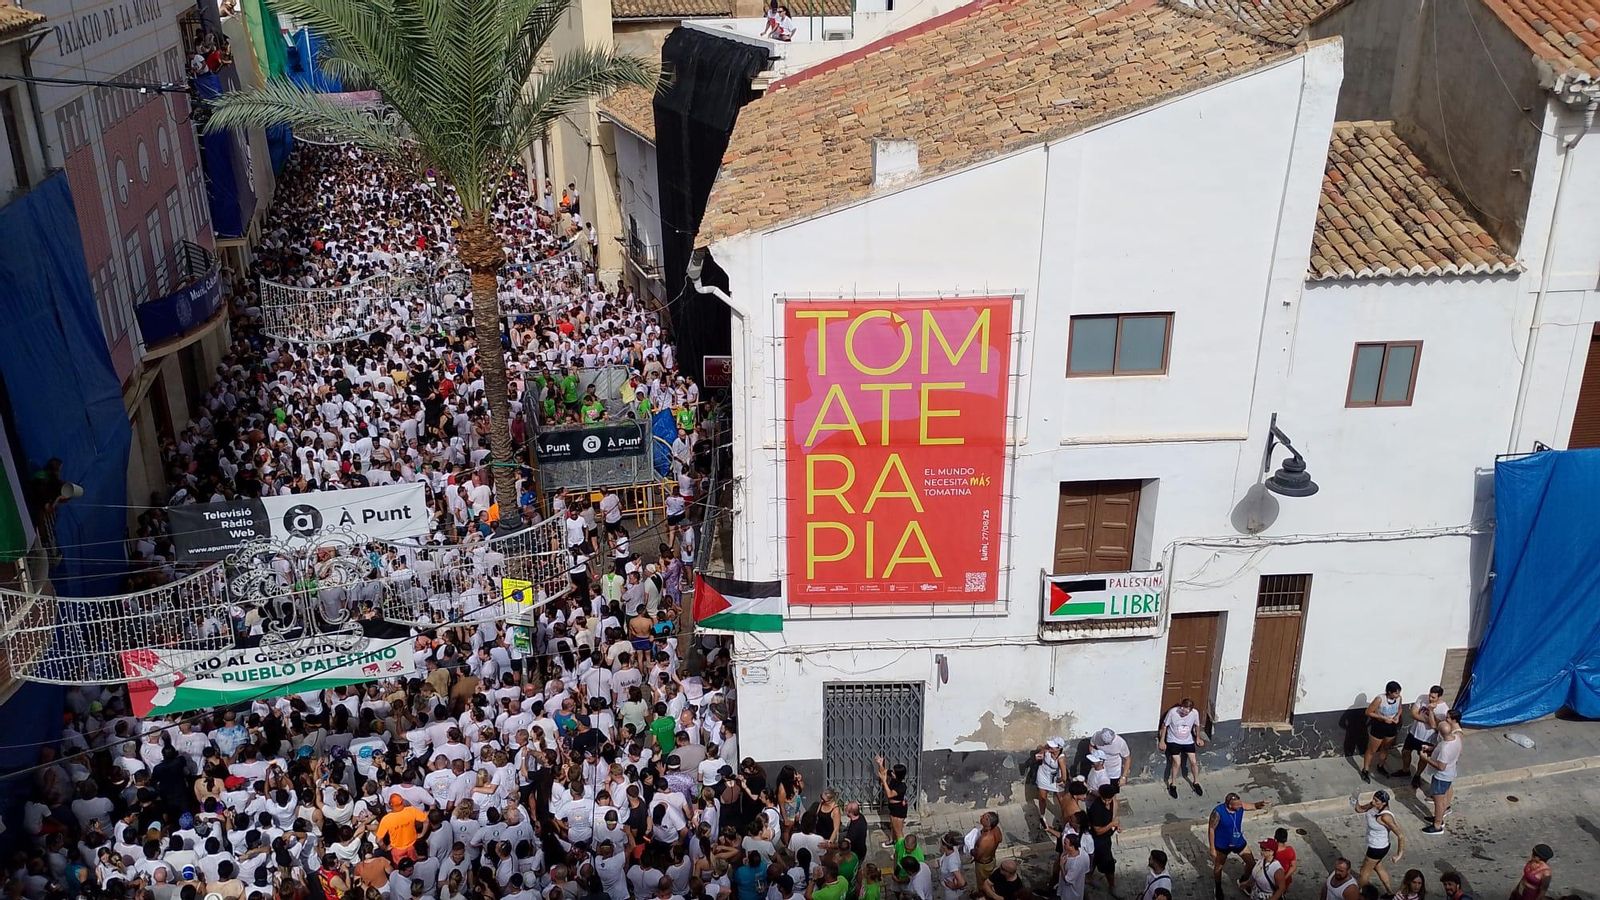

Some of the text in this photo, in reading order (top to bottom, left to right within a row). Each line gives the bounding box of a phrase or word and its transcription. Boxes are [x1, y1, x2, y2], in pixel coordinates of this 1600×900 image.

[54, 13, 102, 57] PALACIO
[103, 8, 118, 37] DE
[119, 4, 133, 31] LA
[795, 308, 991, 376] TOM
[804, 382, 966, 447] ATE
[546, 443, 571, 453] Punt
[924, 467, 975, 476] EL MUNDO
[806, 453, 925, 515] RA
[924, 478, 969, 486] NECESITA
[923, 488, 972, 496] TOMATINA
[203, 508, 252, 520] Televisió
[221, 518, 253, 529] Ràdio
[339, 507, 356, 526] À
[362, 505, 412, 524] Punt
[229, 528, 255, 538] Web
[981, 509, 990, 541] 27/08/25
[806, 520, 943, 580] PIA
[194, 657, 222, 672] NO
[227, 655, 250, 667] AL
[196, 673, 219, 681] DEL
[221, 663, 296, 684] PUEBLO
[302, 647, 397, 673] PALESTINO
